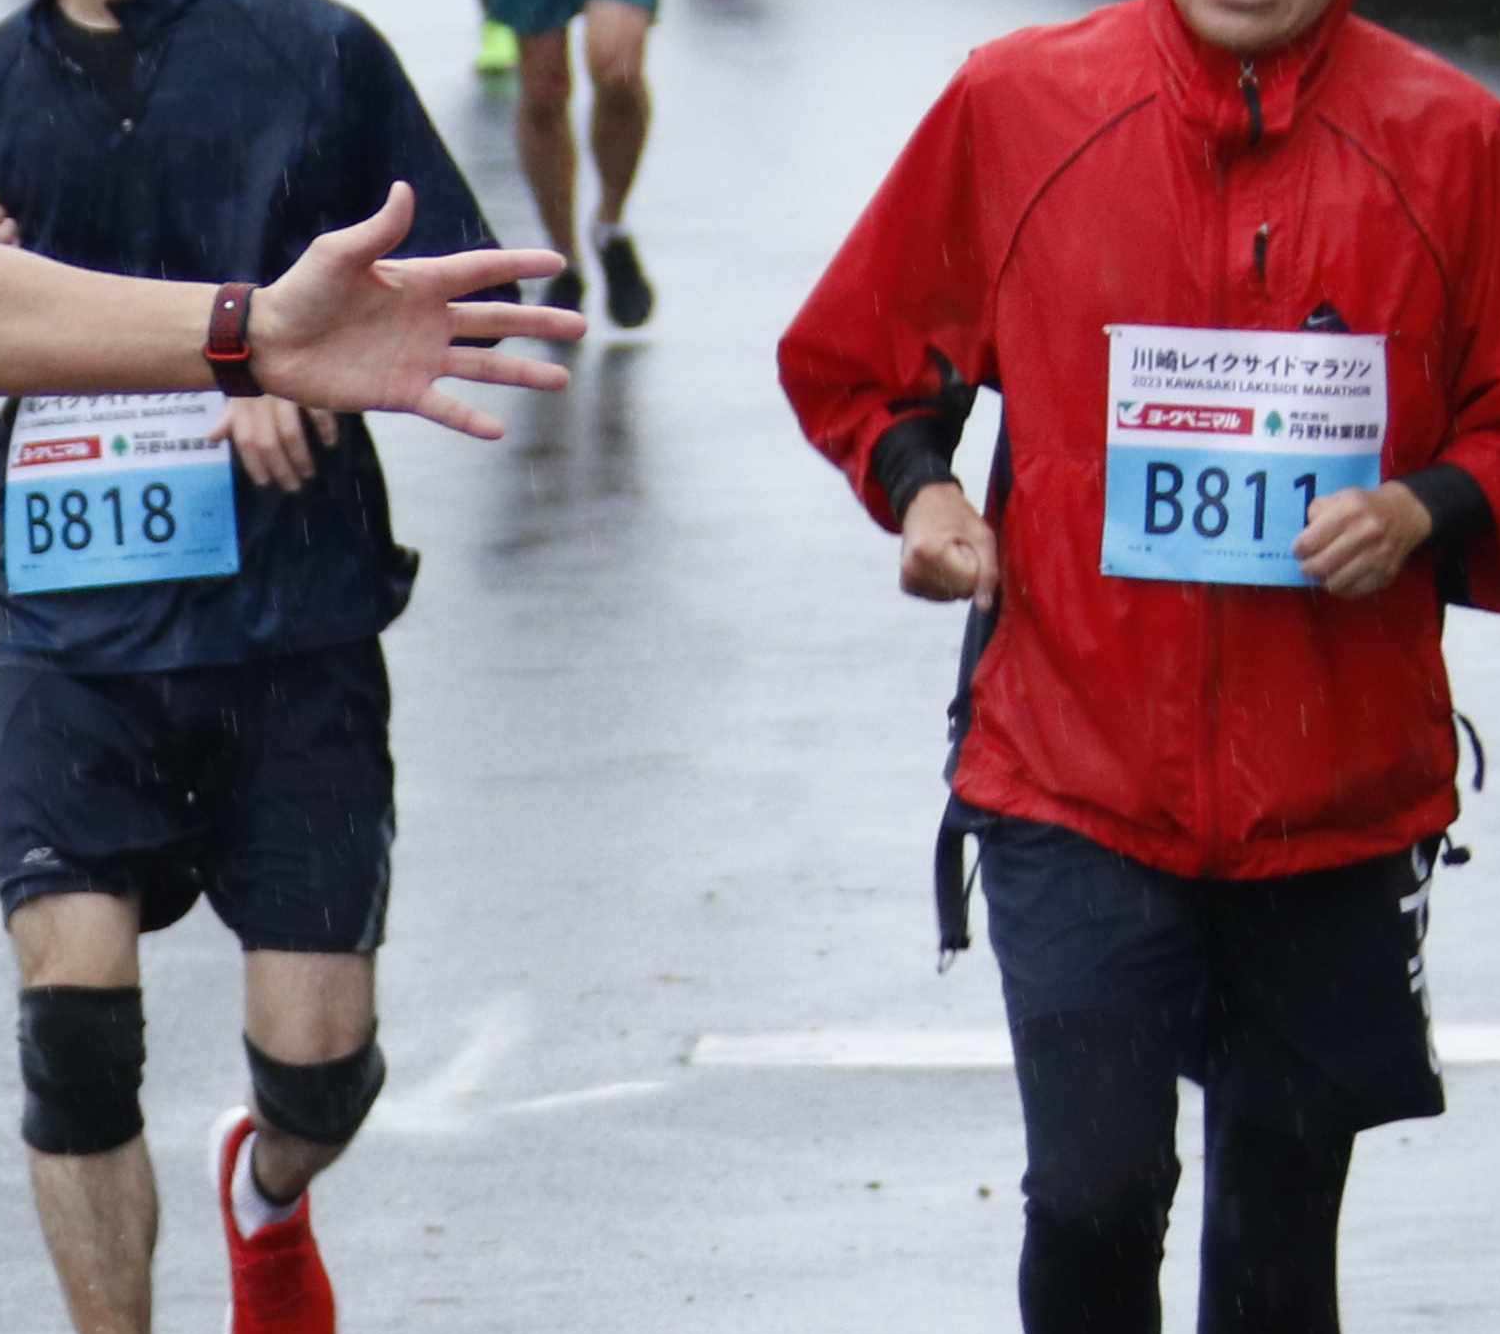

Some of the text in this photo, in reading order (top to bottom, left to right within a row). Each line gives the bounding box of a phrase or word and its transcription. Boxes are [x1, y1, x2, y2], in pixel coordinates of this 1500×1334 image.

[1131, 347, 1373, 380] 川崎レイクサイドマラソン
[1132, 375, 1163, 389] 2023
[1165, 377, 1236, 392] KAWASAKI
[1239, 381, 1299, 395] LAKESIDE
[1146, 409, 1241, 429] ヨークベニマル
[1144, 461, 1317, 541] B811
[25, 482, 176, 555] B818
